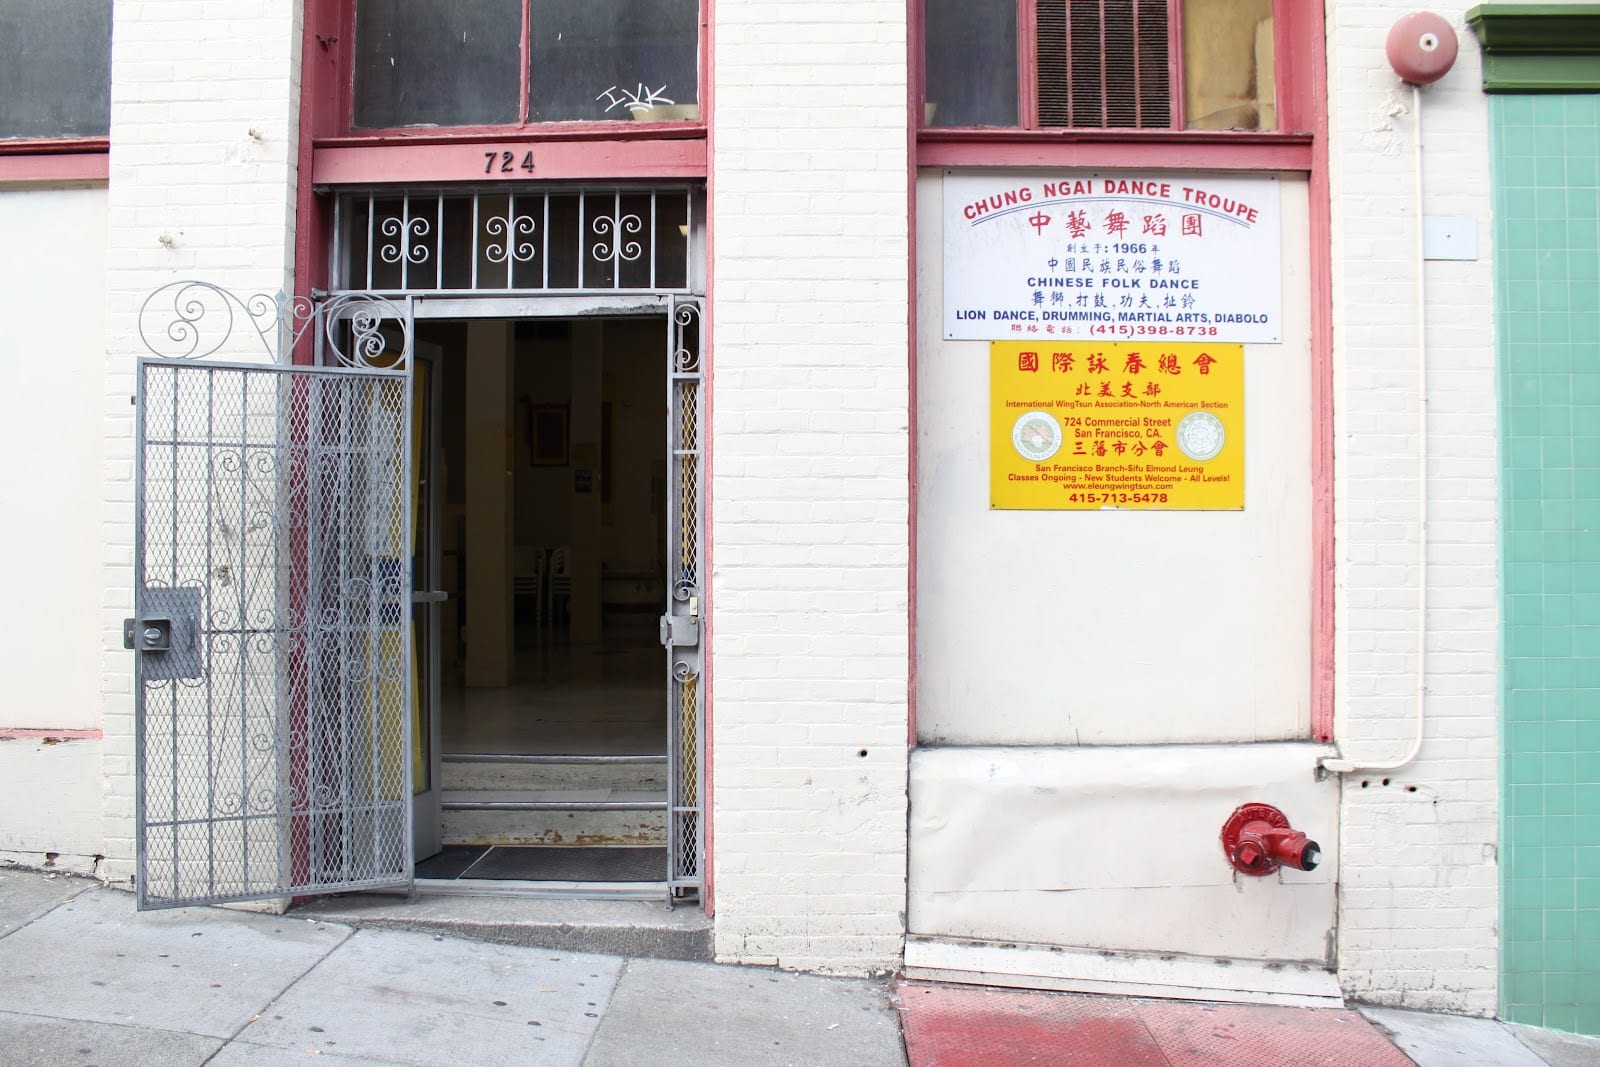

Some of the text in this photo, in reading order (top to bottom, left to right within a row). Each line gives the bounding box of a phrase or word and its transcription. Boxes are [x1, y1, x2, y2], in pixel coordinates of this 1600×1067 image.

[483, 149, 537, 174] 724
[964, 180, 1259, 225] CHUNG NGAI DANCE TROUPE
[1028, 209, 1203, 239] 中藝舞蹈團
[1113, 243, 1147, 254] 1966
[1048, 257, 1179, 274] 中國民族民俗舞蹈
[1028, 277, 1200, 289] CHINESE FOLK DANCE
[957, 310, 1268, 324] LION DANCE, DRUMMING, MARTIAL ARTS, DIABOLO
[1090, 325, 1217, 337] (415)398-8738
[1018, 352, 1216, 375] 國際詠春總會
[1076, 381, 1161, 398] 北美支部
[1006, 400, 1054, 408] International
[1056, 400, 1092, 409] WingTsun
[1201, 401, 1228, 409] Section
[1064, 417, 1171, 426] 724 Commercial Street
[1075, 428, 1161, 438] San Francisco, CA.
[1072, 440, 1168, 456] 三藩市分會
[1036, 464, 1204, 474] San Francisco Branch-Sifu Elmond Leung
[1008, 474, 1040, 482] Classes
[1042, 474, 1077, 482] Ongoing
[1085, 474, 1104, 482] New
[1106, 474, 1143, 482] Students
[1063, 482, 1173, 491] www.eleungwingtsun.com
[1069, 493, 1168, 503] 415-713-5478
